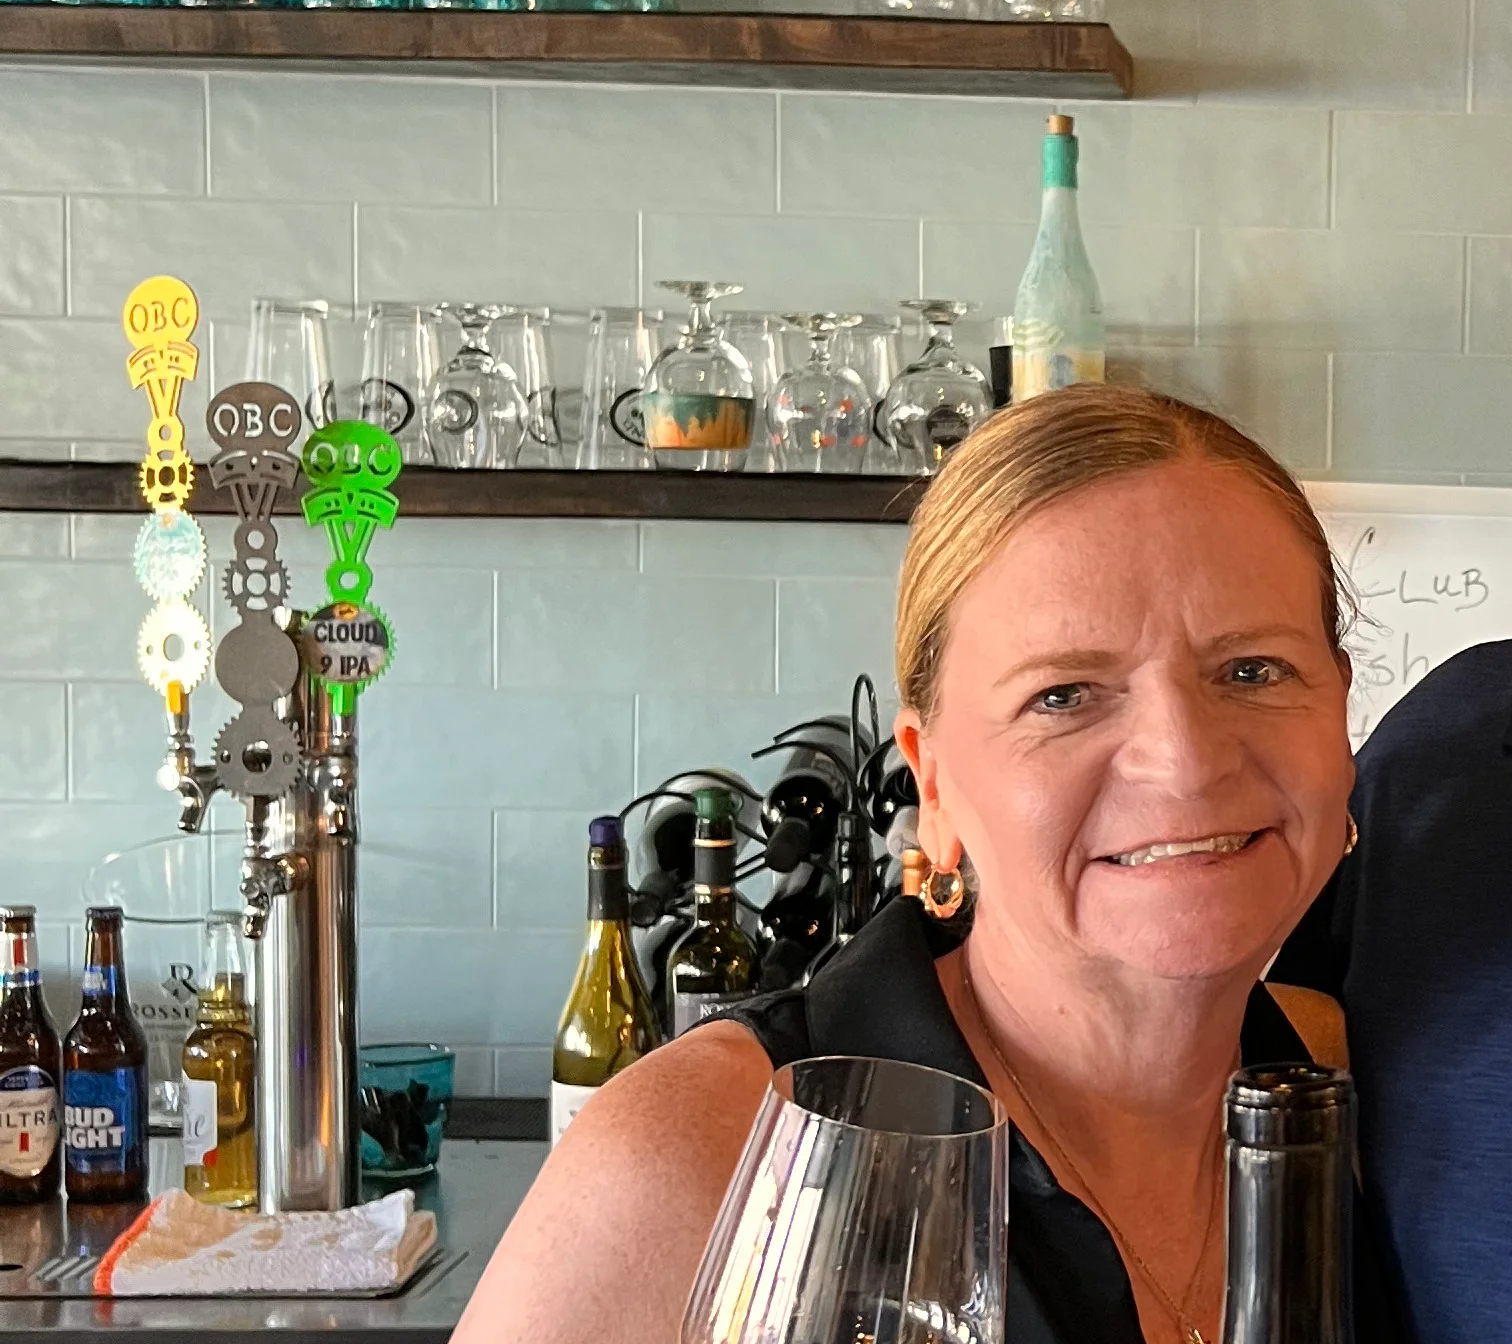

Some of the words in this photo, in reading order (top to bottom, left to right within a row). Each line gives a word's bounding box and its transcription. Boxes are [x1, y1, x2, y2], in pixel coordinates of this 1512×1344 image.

[129, 296, 191, 333] OBC
[213, 402, 293, 439] OBC
[310, 442, 392, 476] OBC
[314, 623, 378, 644] CLOUD
[320, 654, 333, 675] 9
[341, 655, 371, 675] IPA
[0, 1109, 58, 1128] LTRA
[65, 1104, 114, 1129] BUD
